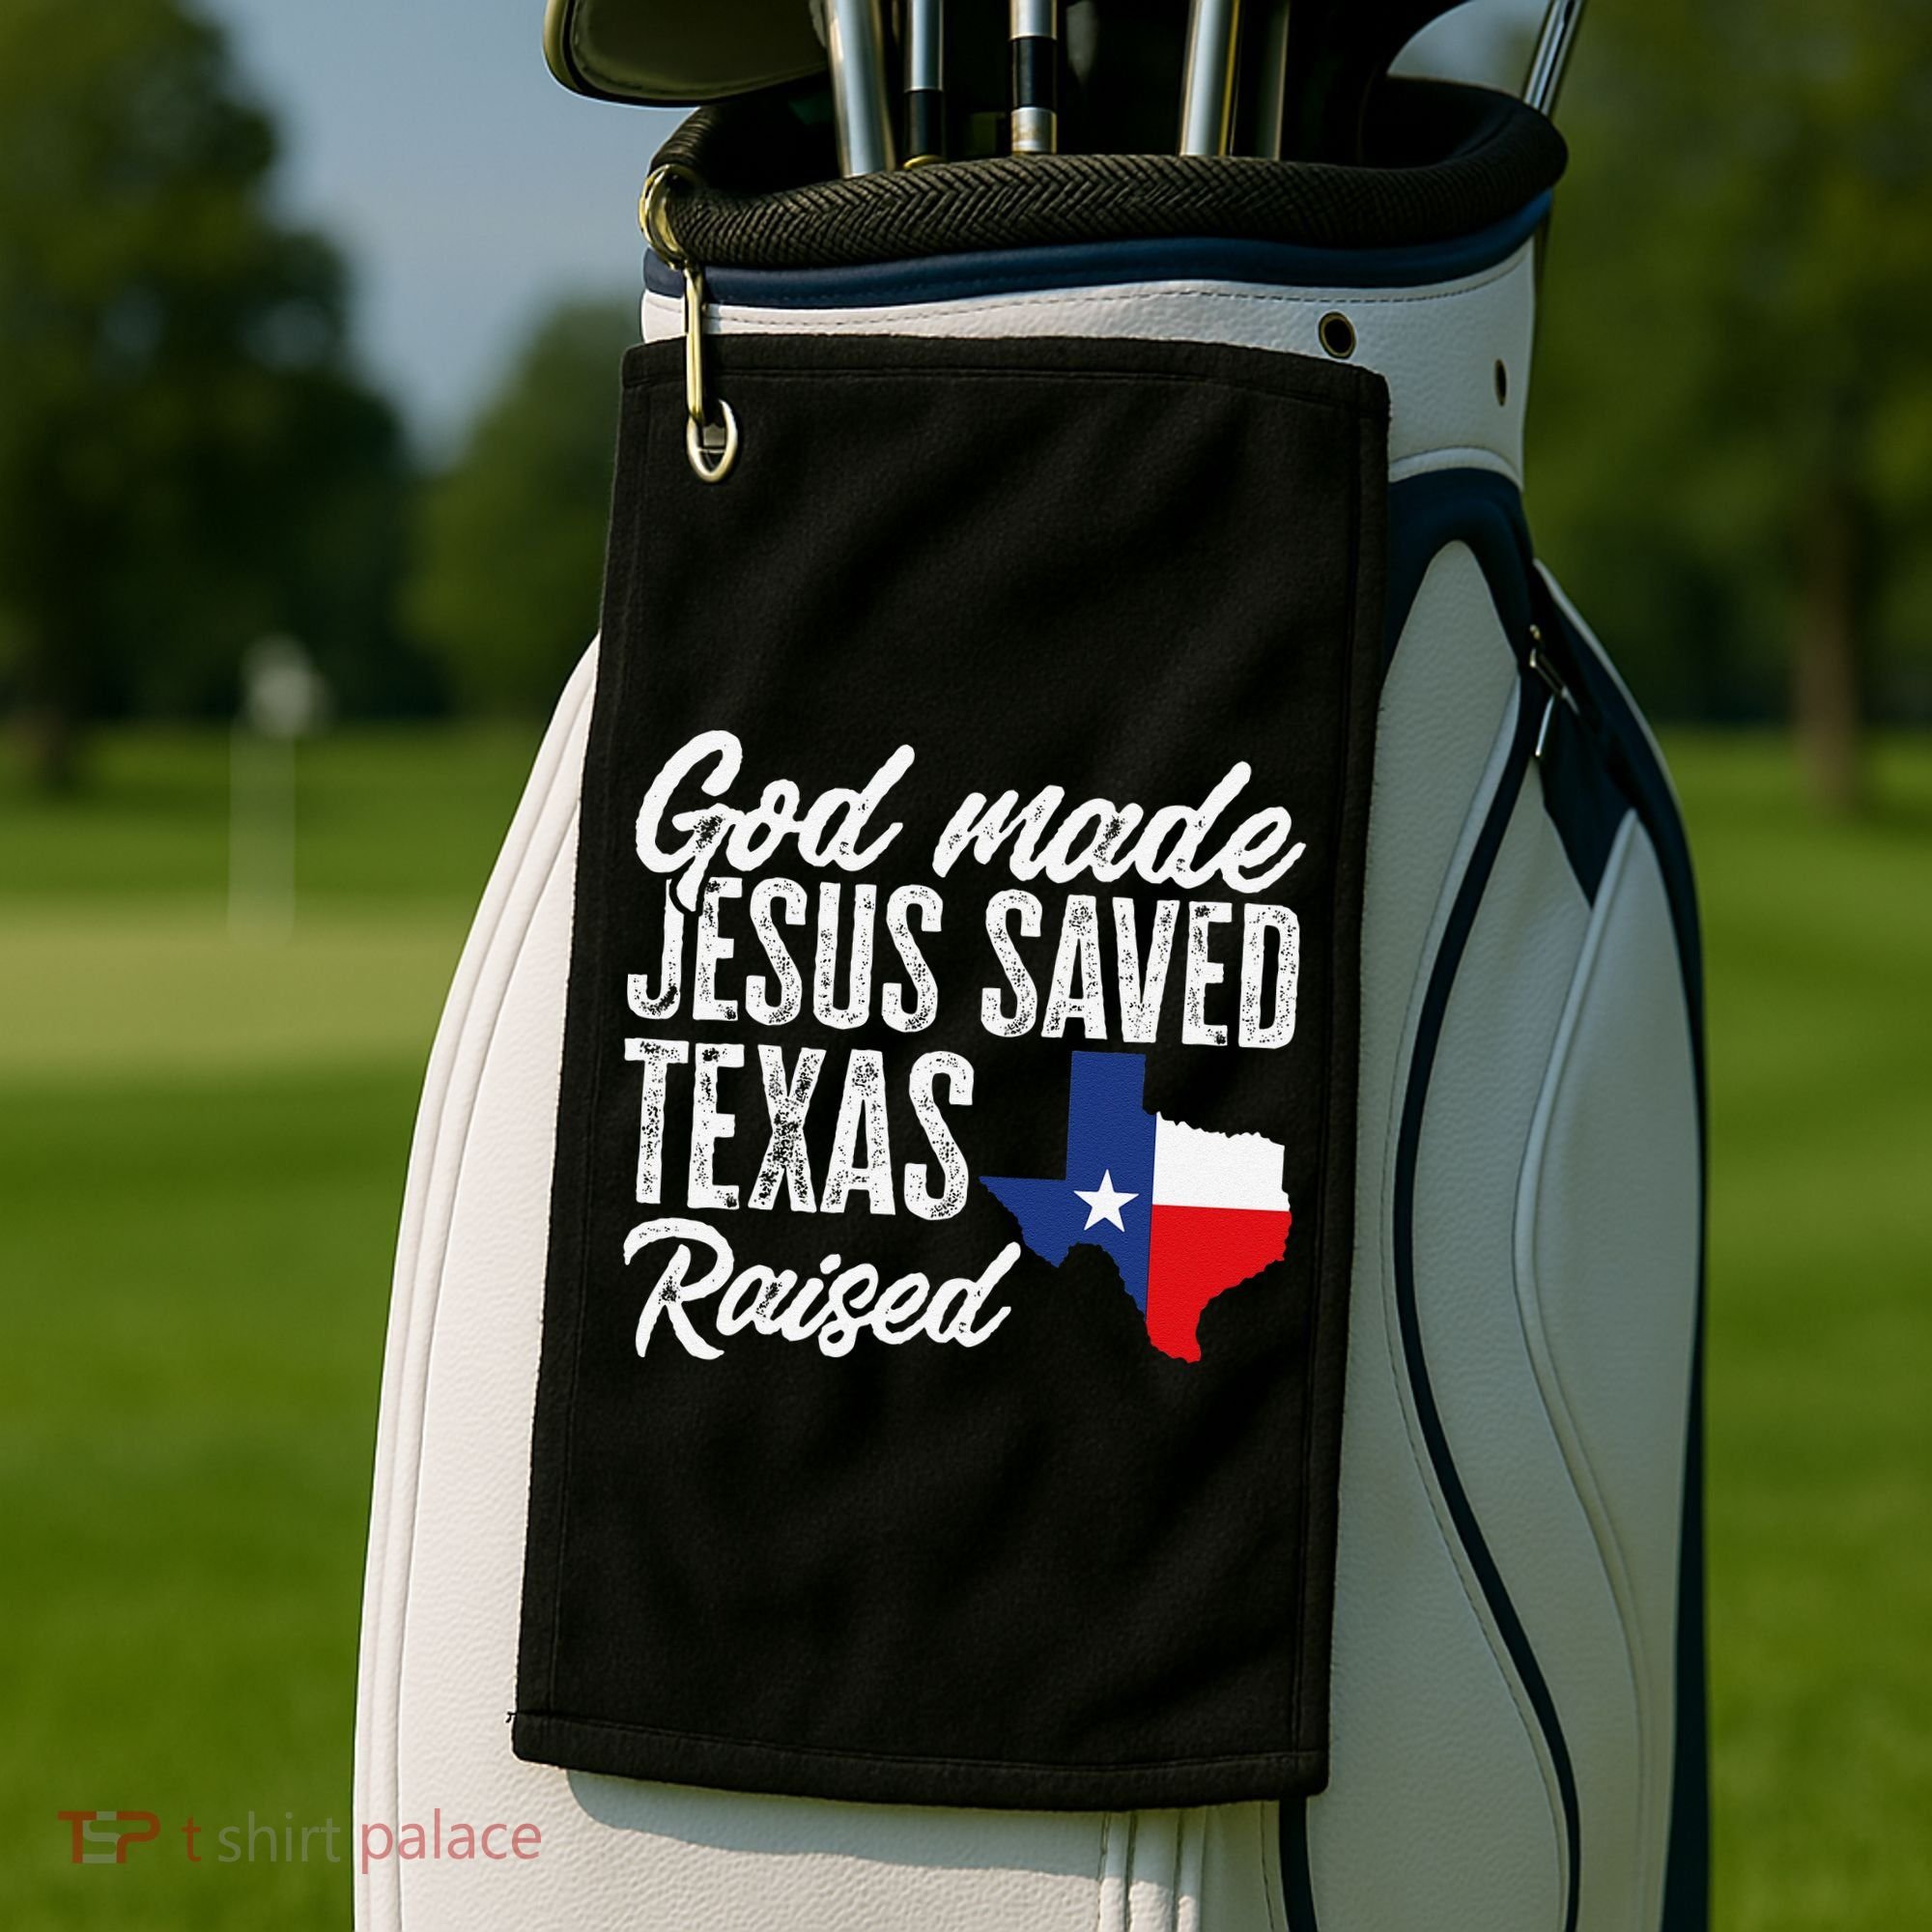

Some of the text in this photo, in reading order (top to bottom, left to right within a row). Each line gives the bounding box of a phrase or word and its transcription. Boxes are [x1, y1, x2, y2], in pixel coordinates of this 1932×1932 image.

[635, 729, 1307, 913] God made
[626, 876, 1301, 1050] JESUS SAVED
[624, 1037, 976, 1221] TEXAS
[622, 1217, 1022, 1360] Raised
